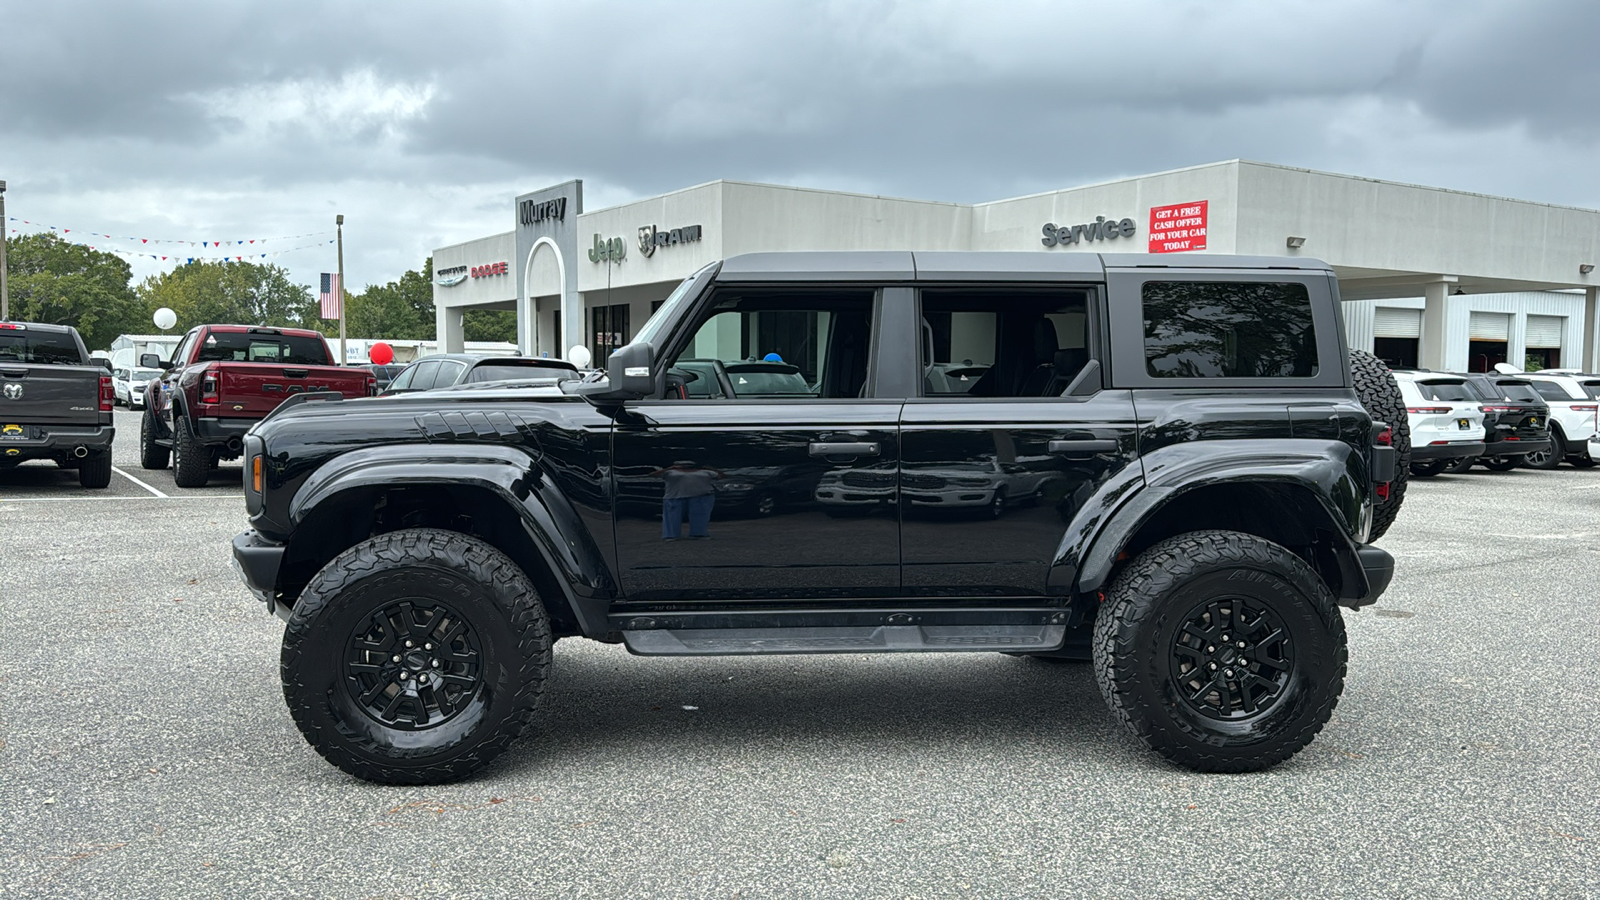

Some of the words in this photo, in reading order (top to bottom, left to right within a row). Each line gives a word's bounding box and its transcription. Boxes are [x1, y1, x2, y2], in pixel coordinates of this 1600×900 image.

[520, 197, 567, 225] Murray
[1156, 209, 1172, 219] GET
[1173, 209, 1178, 217] A
[1180, 206, 1201, 217] FREE
[1042, 217, 1135, 246] Service
[1154, 220, 1174, 230] CASH
[1176, 218, 1202, 227] OFFER
[655, 225, 702, 247] RAM
[1150, 233, 1165, 241] FOR
[1167, 231, 1188, 239] YOUR
[1190, 228, 1206, 236] CAR
[588, 232, 626, 264] Jeep
[1164, 241, 1190, 250] TODAY
[471, 262, 508, 279] DODGE
[262, 384, 329, 392] RAM
